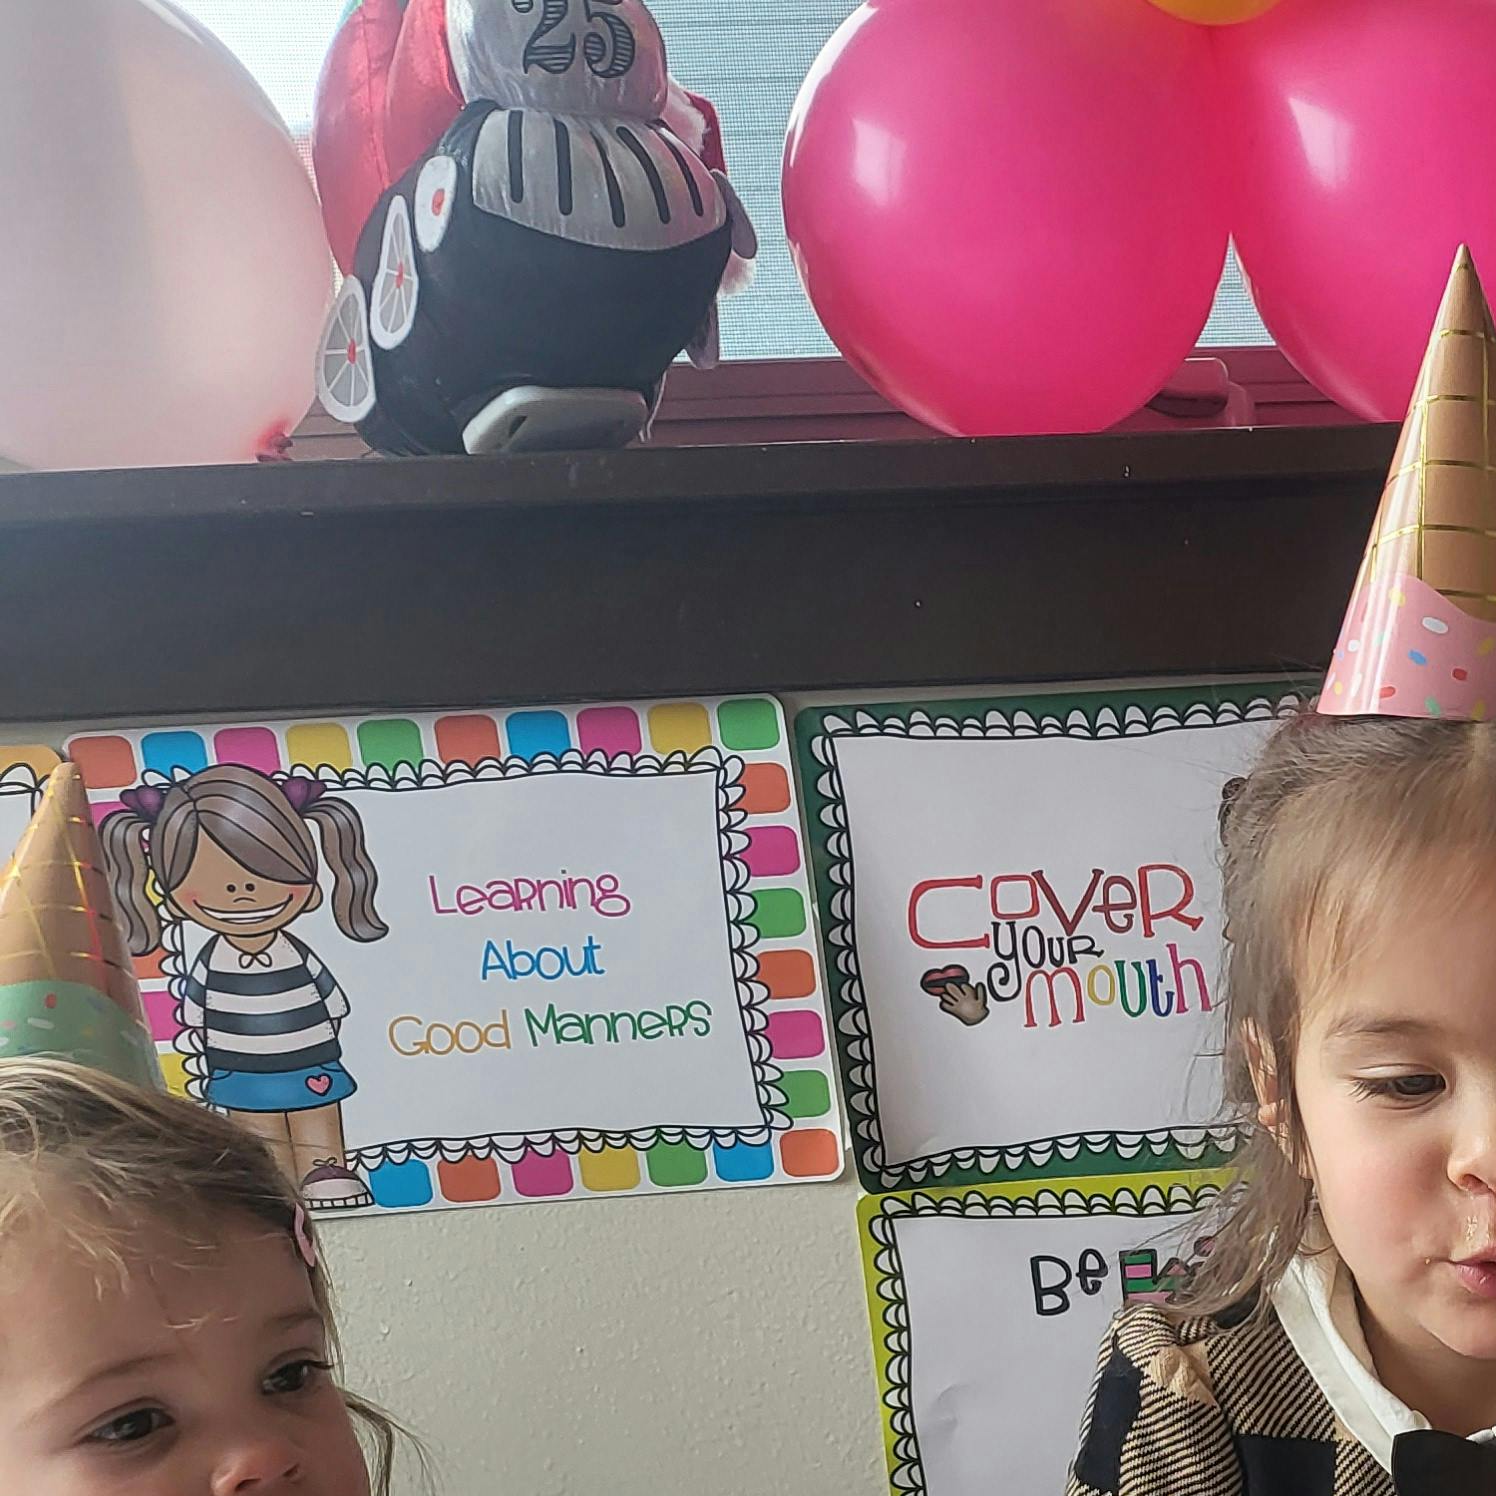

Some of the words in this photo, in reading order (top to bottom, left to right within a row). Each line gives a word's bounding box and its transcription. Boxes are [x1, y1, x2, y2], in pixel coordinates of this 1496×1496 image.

[480, 935, 606, 980] About
[388, 1008, 513, 1056] Good
[1029, 1248, 1110, 1316] Be
